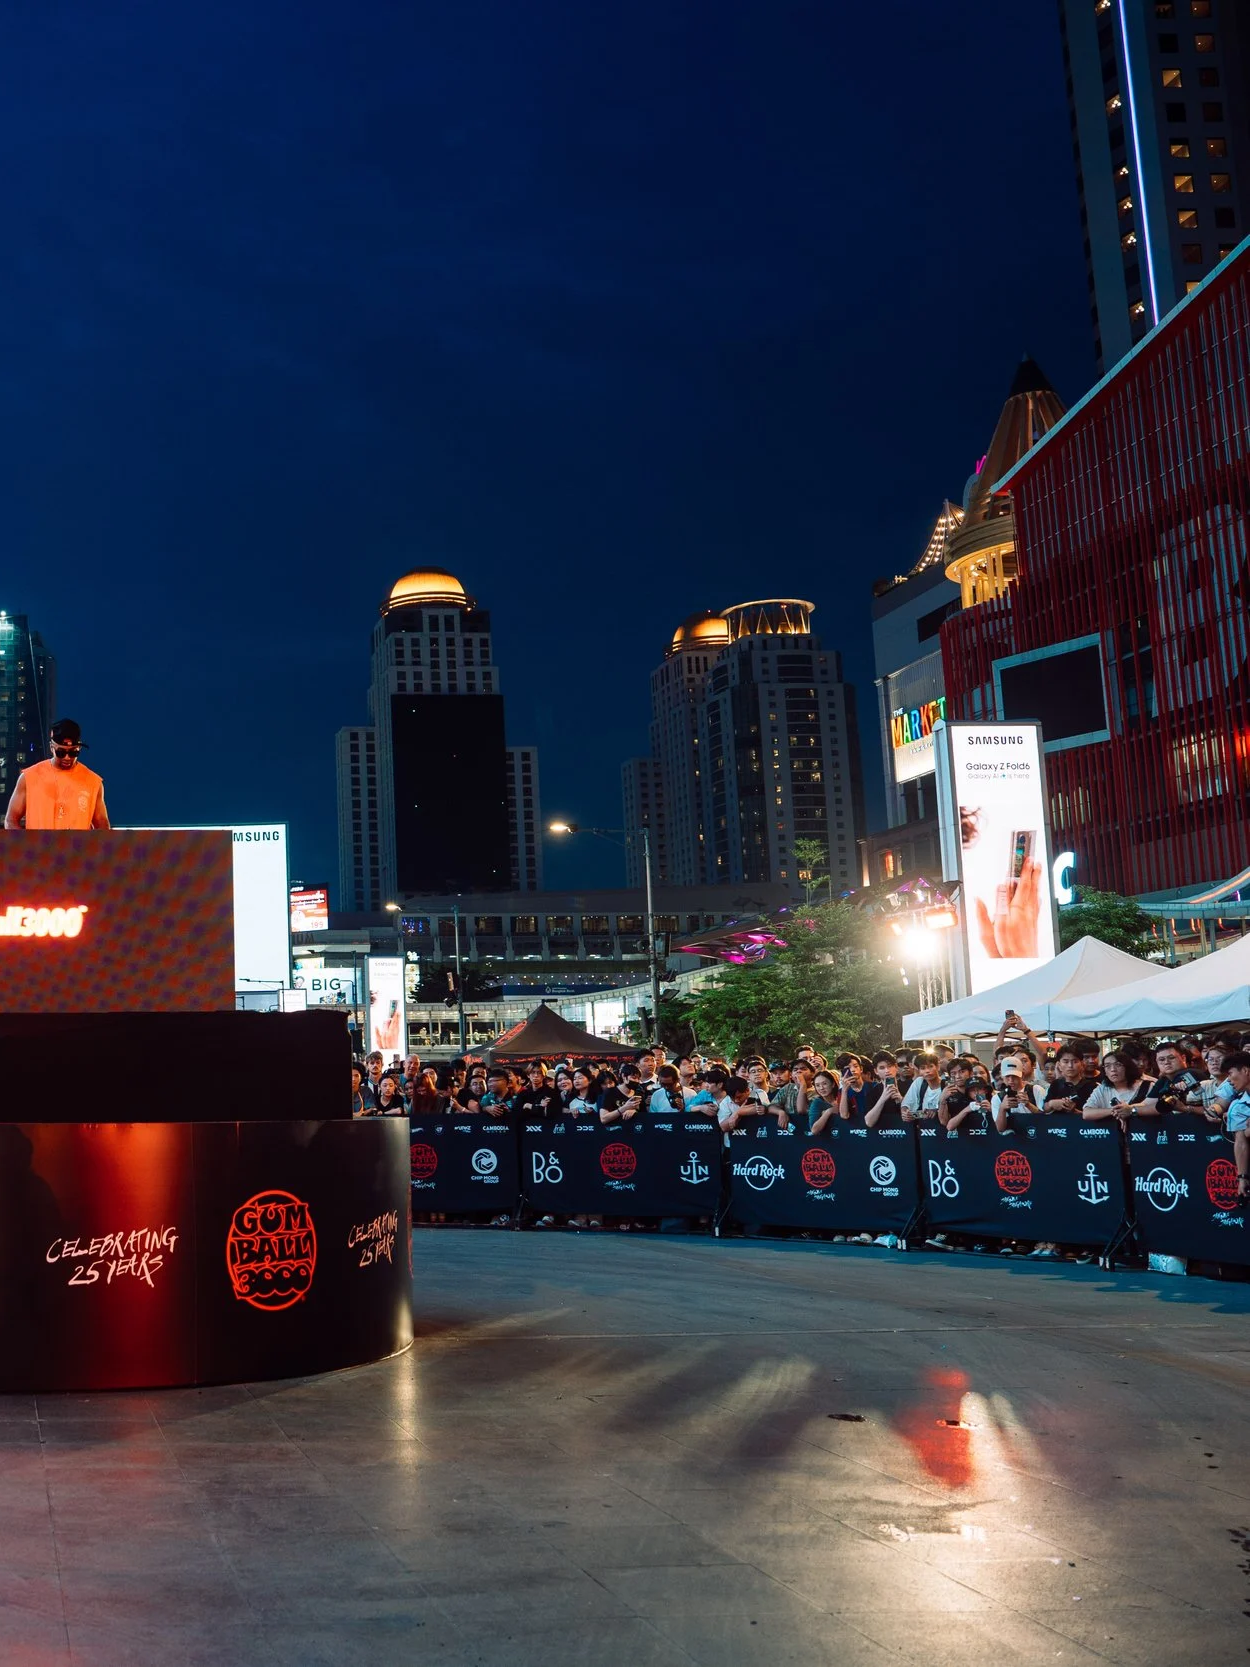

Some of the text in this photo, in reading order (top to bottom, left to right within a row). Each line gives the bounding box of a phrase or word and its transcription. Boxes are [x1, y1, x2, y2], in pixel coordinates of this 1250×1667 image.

[891, 695, 947, 748] MARKET
[893, 707, 904, 718] THE
[967, 735, 1024, 746] SAMSUNG
[966, 762, 1031, 773] Galaxy Z Fold6
[233, 830, 280, 842] MSUNG
[311, 978, 342, 991] BIG
[733, 1163, 785, 1179] Hard Rock
[1134, 1176, 1189, 1197] Hard Rock
[233, 1201, 312, 1235] GUM
[347, 1209, 399, 1249] CELEBRATING
[46, 1224, 178, 1263] CELEBRATING
[230, 1233, 316, 1267] BALL
[358, 1237, 396, 1268] 25 YEARS
[67, 1252, 164, 1288] 25 YEARS
